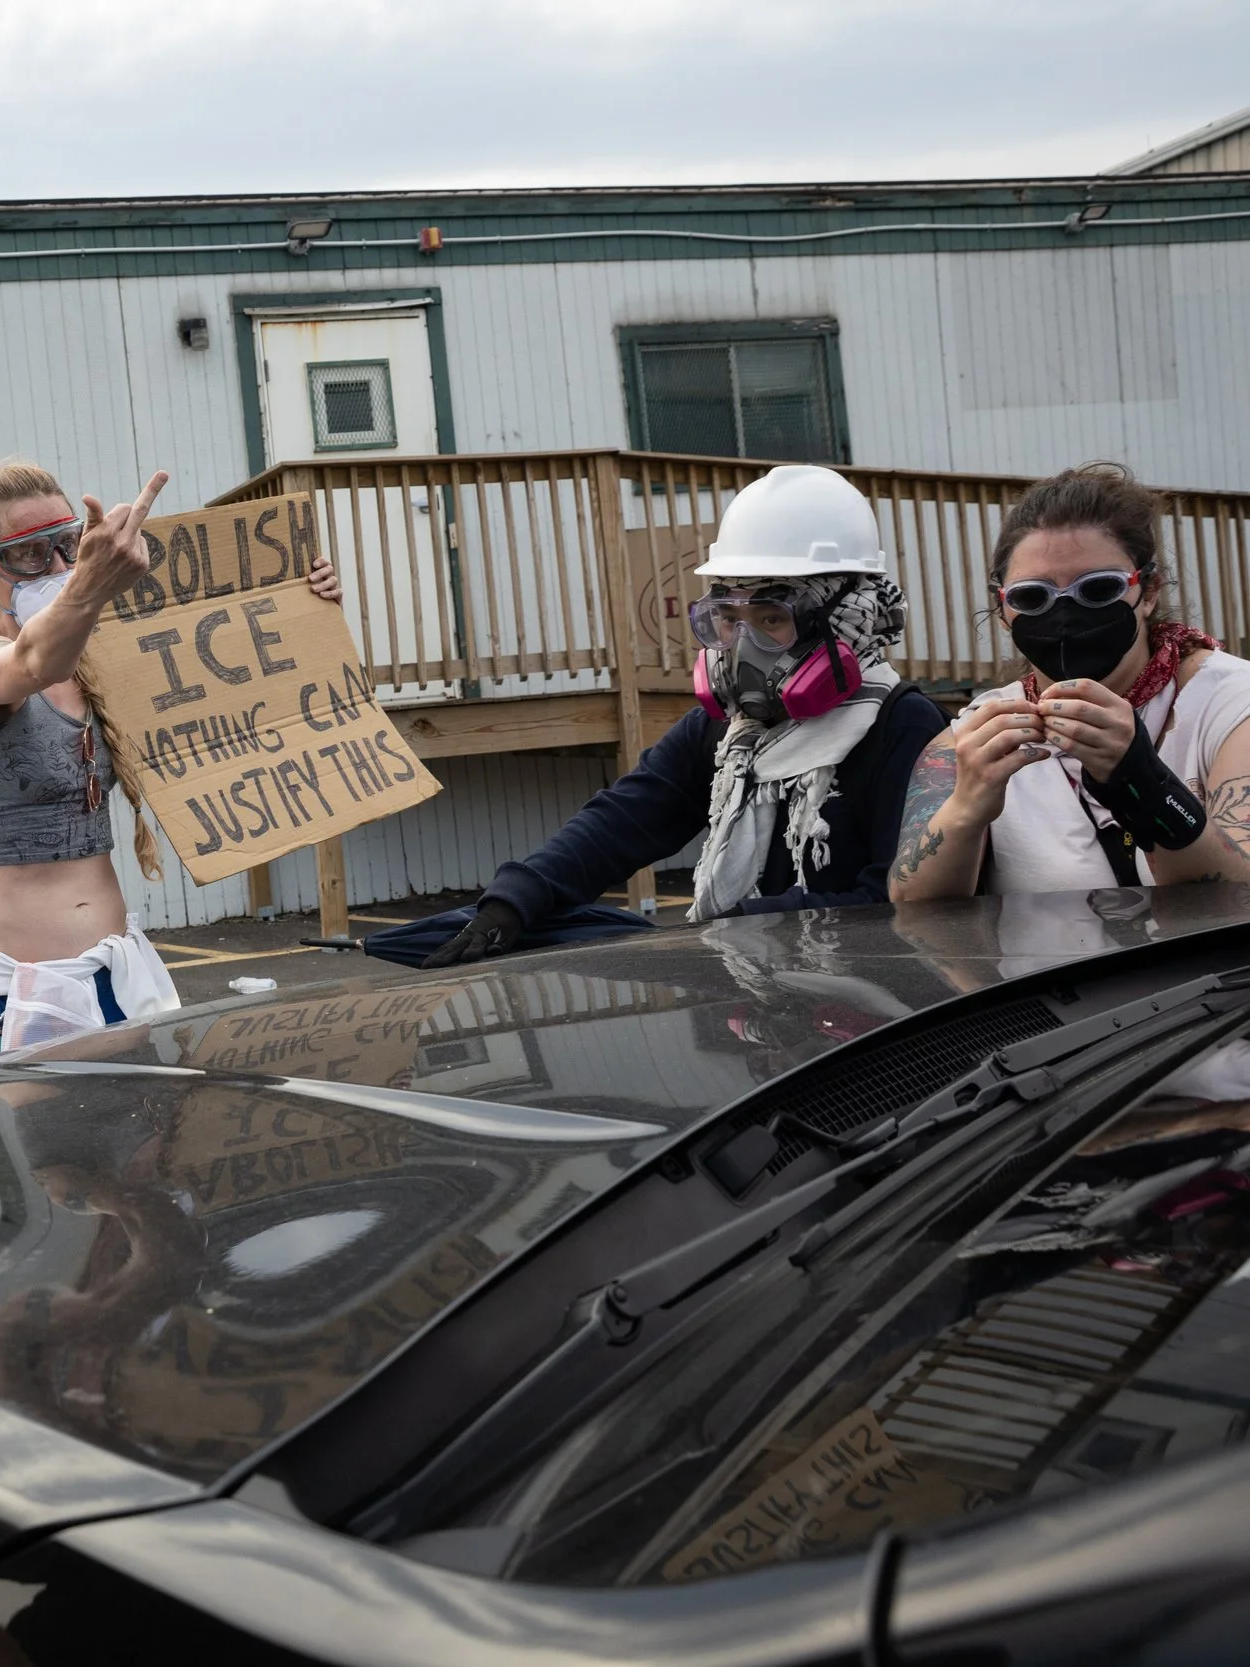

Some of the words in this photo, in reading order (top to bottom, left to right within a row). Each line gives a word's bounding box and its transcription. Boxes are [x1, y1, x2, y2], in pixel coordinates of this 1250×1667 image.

[137, 598, 298, 714] ICE
[127, 701, 285, 784] NOTHING
[299, 661, 379, 732] CAN
[185, 749, 334, 856] JUSTIFY
[319, 729, 416, 802] THIS
[1169, 798, 1197, 825] MUELLER
